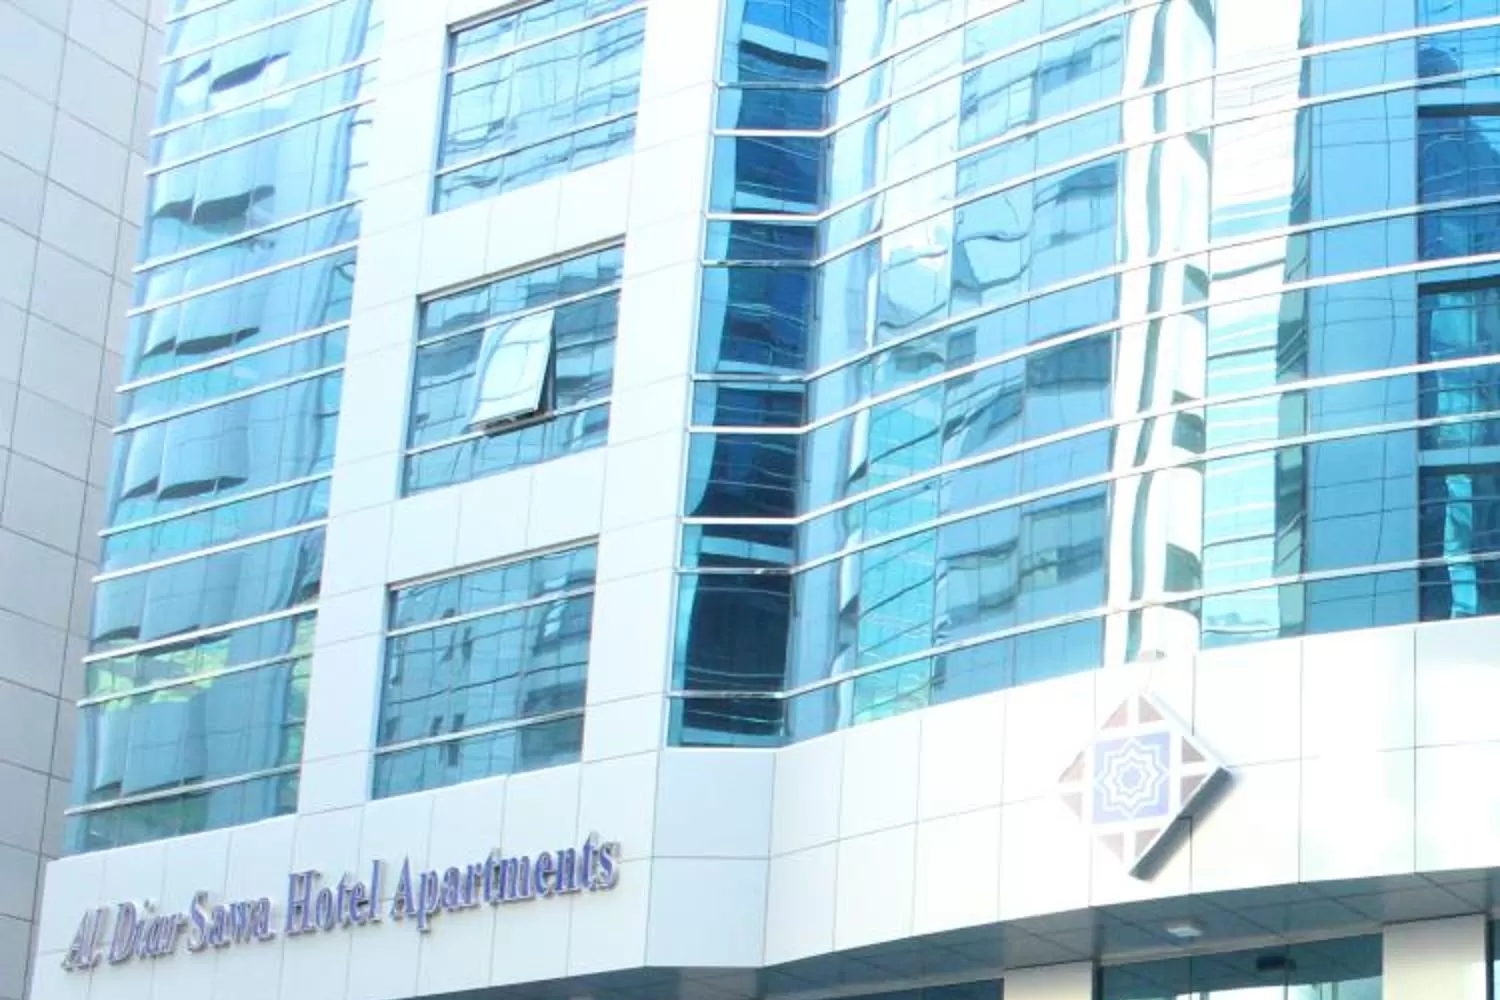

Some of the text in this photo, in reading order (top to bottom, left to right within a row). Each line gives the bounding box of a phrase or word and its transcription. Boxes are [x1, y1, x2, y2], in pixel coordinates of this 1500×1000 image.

[61, 832, 622, 972] Al Diar Sawa Hotel Apartments
